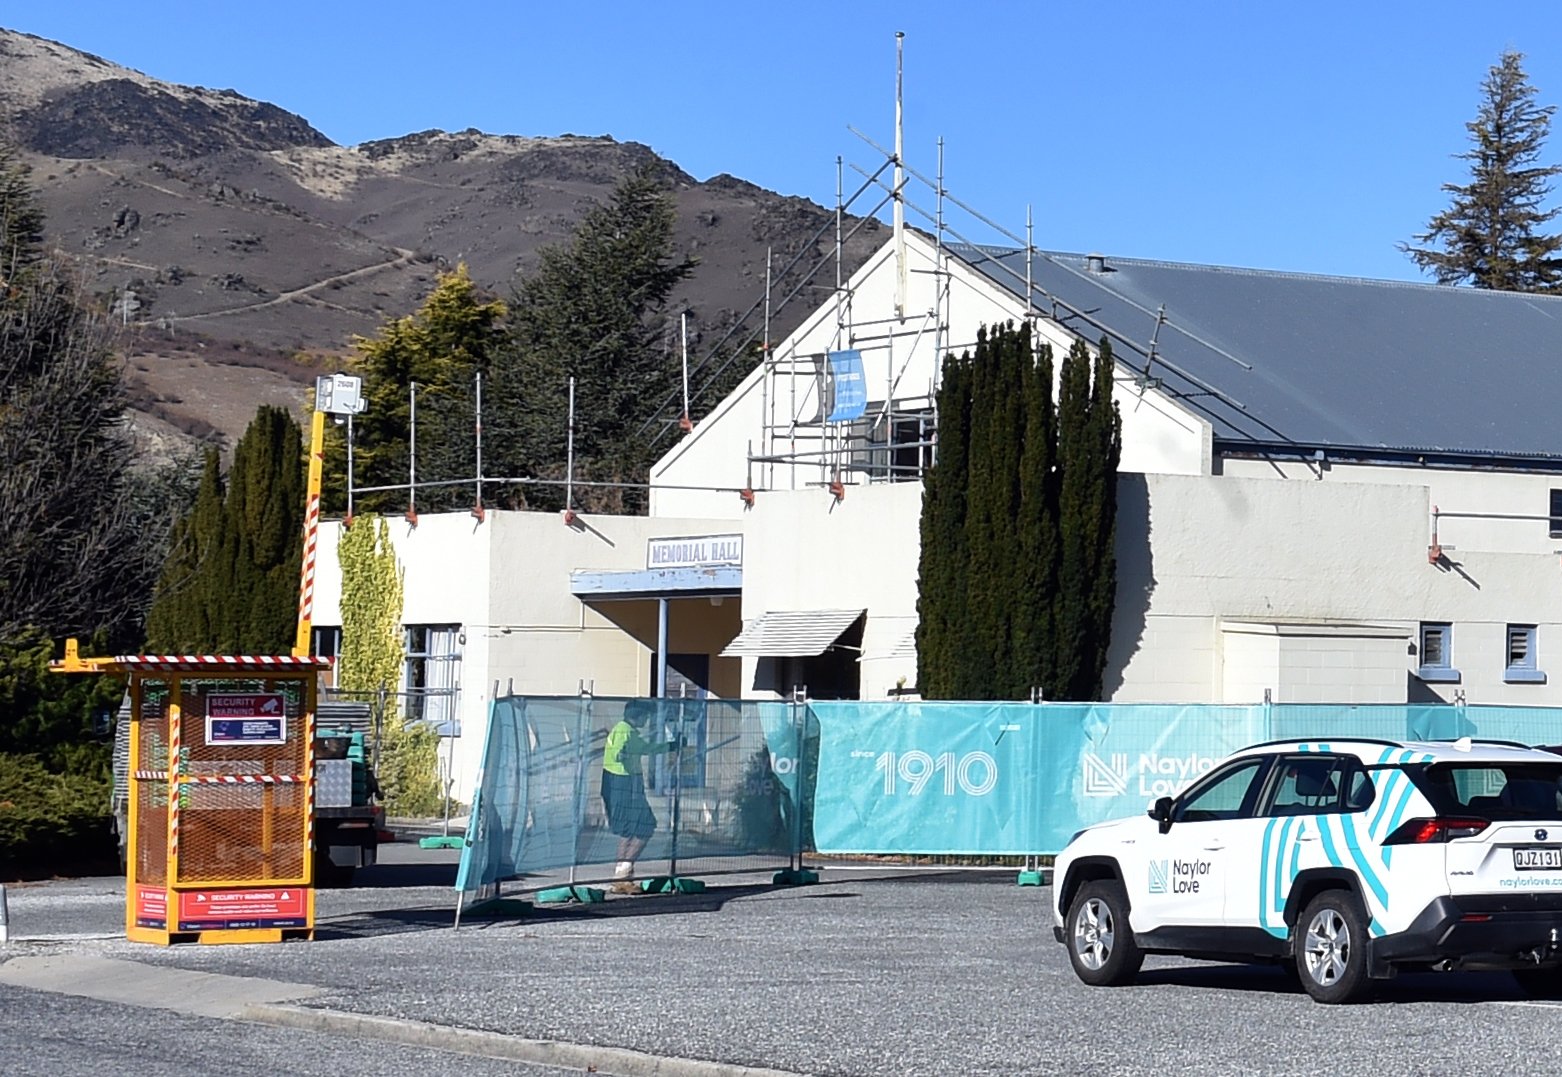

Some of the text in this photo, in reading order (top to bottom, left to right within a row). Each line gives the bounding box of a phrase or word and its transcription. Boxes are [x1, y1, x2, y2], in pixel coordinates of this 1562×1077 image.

[652, 542, 739, 563] MEMORIAL HALL
[211, 697, 256, 706] SECURITY
[212, 707, 255, 716] WARNING
[850, 749, 998, 796] since 1910
[1515, 851, 1560, 866] QJZ131
[1173, 858, 1212, 879] Naylor
[1172, 876, 1200, 894] Love
[211, 893, 243, 902] SECURITY
